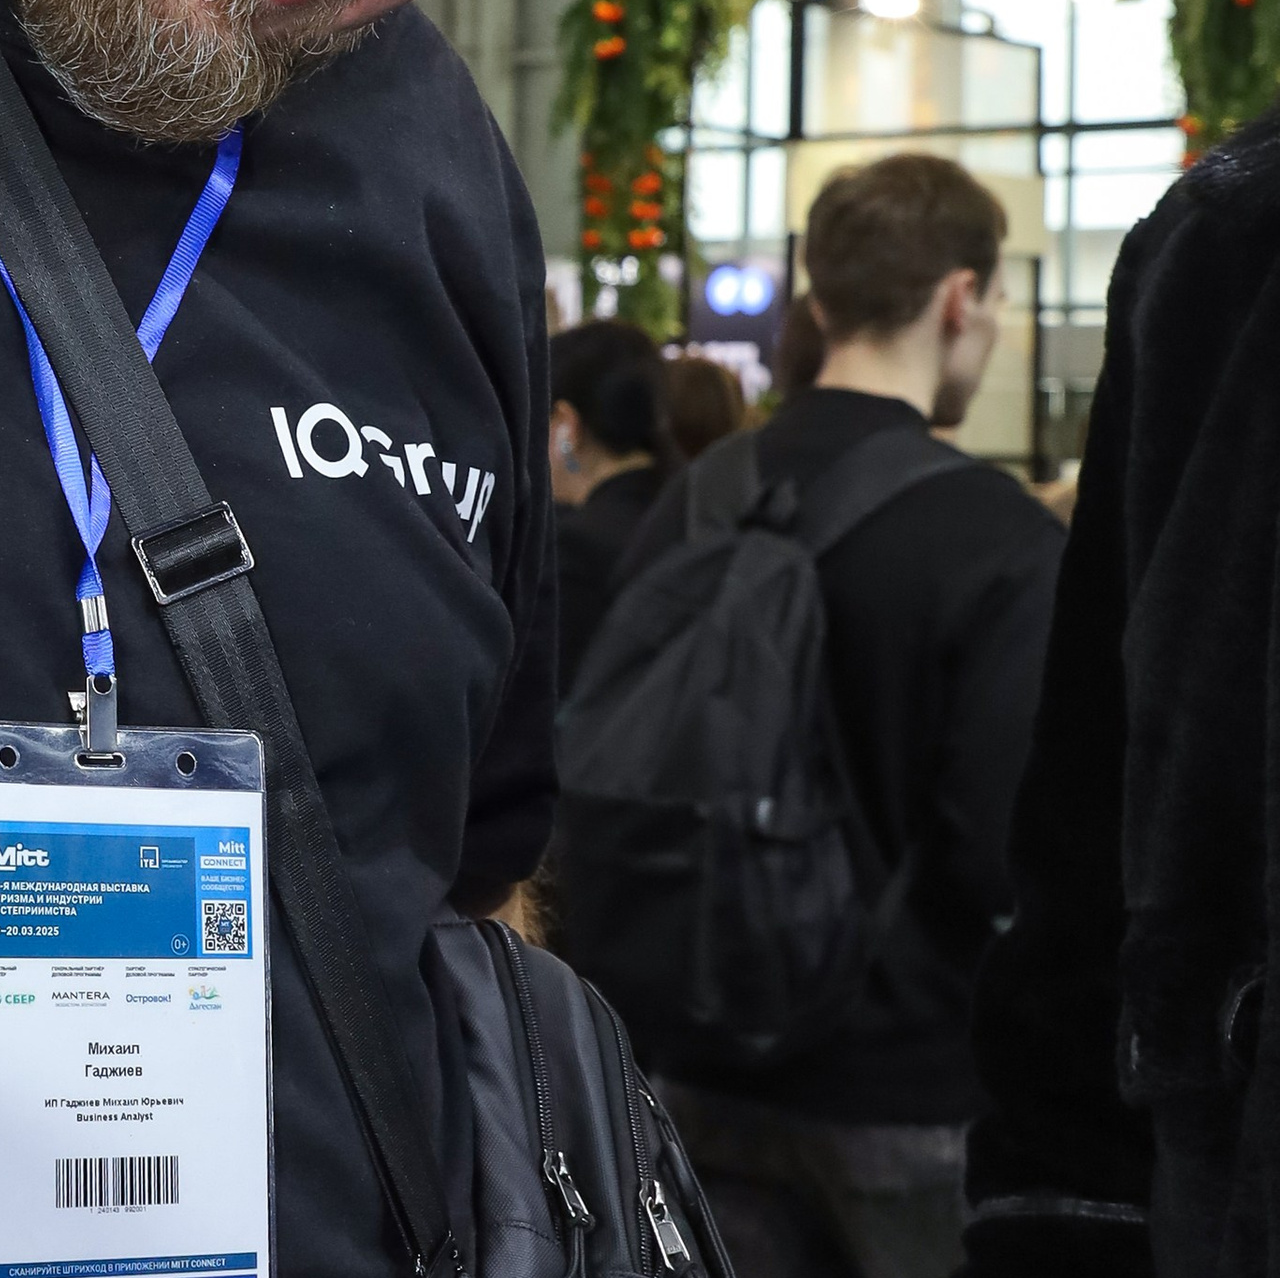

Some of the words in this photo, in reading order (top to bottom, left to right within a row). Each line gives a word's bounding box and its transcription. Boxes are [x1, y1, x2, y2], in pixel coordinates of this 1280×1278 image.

[219, 841, 246, 854] Mitt
[203, 858, 243, 867] CONNECT
[11, 882, 98, 893] МЕЖДУНАРОДНАЯ
[100, 883, 150, 893] ВЫСТАВКА
[37, 895, 44, 904] И
[45, 894, 103, 905] ИНДУСТРИИ
[174, 939, 187, 950] 0+
[5, 994, 36, 1004] СБЕР
[51, 991, 110, 1000] MANTERA
[125, 994, 172, 1004] Островок!
[88, 1042, 140, 1055] Михаил
[85, 1064, 143, 1079] Гаджиев
[44, 1099, 58, 1108] ИП
[60, 1099, 100, 1109] Гаджиев
[103, 1097, 139, 1107] Михаил
[141, 1097, 184, 1108] Юрьевич
[76, 1113, 118, 1122] Business
[120, 1112, 154, 1123] Analyst
[9, 1265, 61, 1277] СКАНИРУЙТЕ
[62, 1263, 107, 1275] ШТРИХКОД
[108, 1263, 113, 1272] В
[114, 1260, 171, 1272] ПРИЛОЖЕНИИ
[171, 1259, 190, 1269] MITT
[191, 1257, 226, 1268] CONNECT
